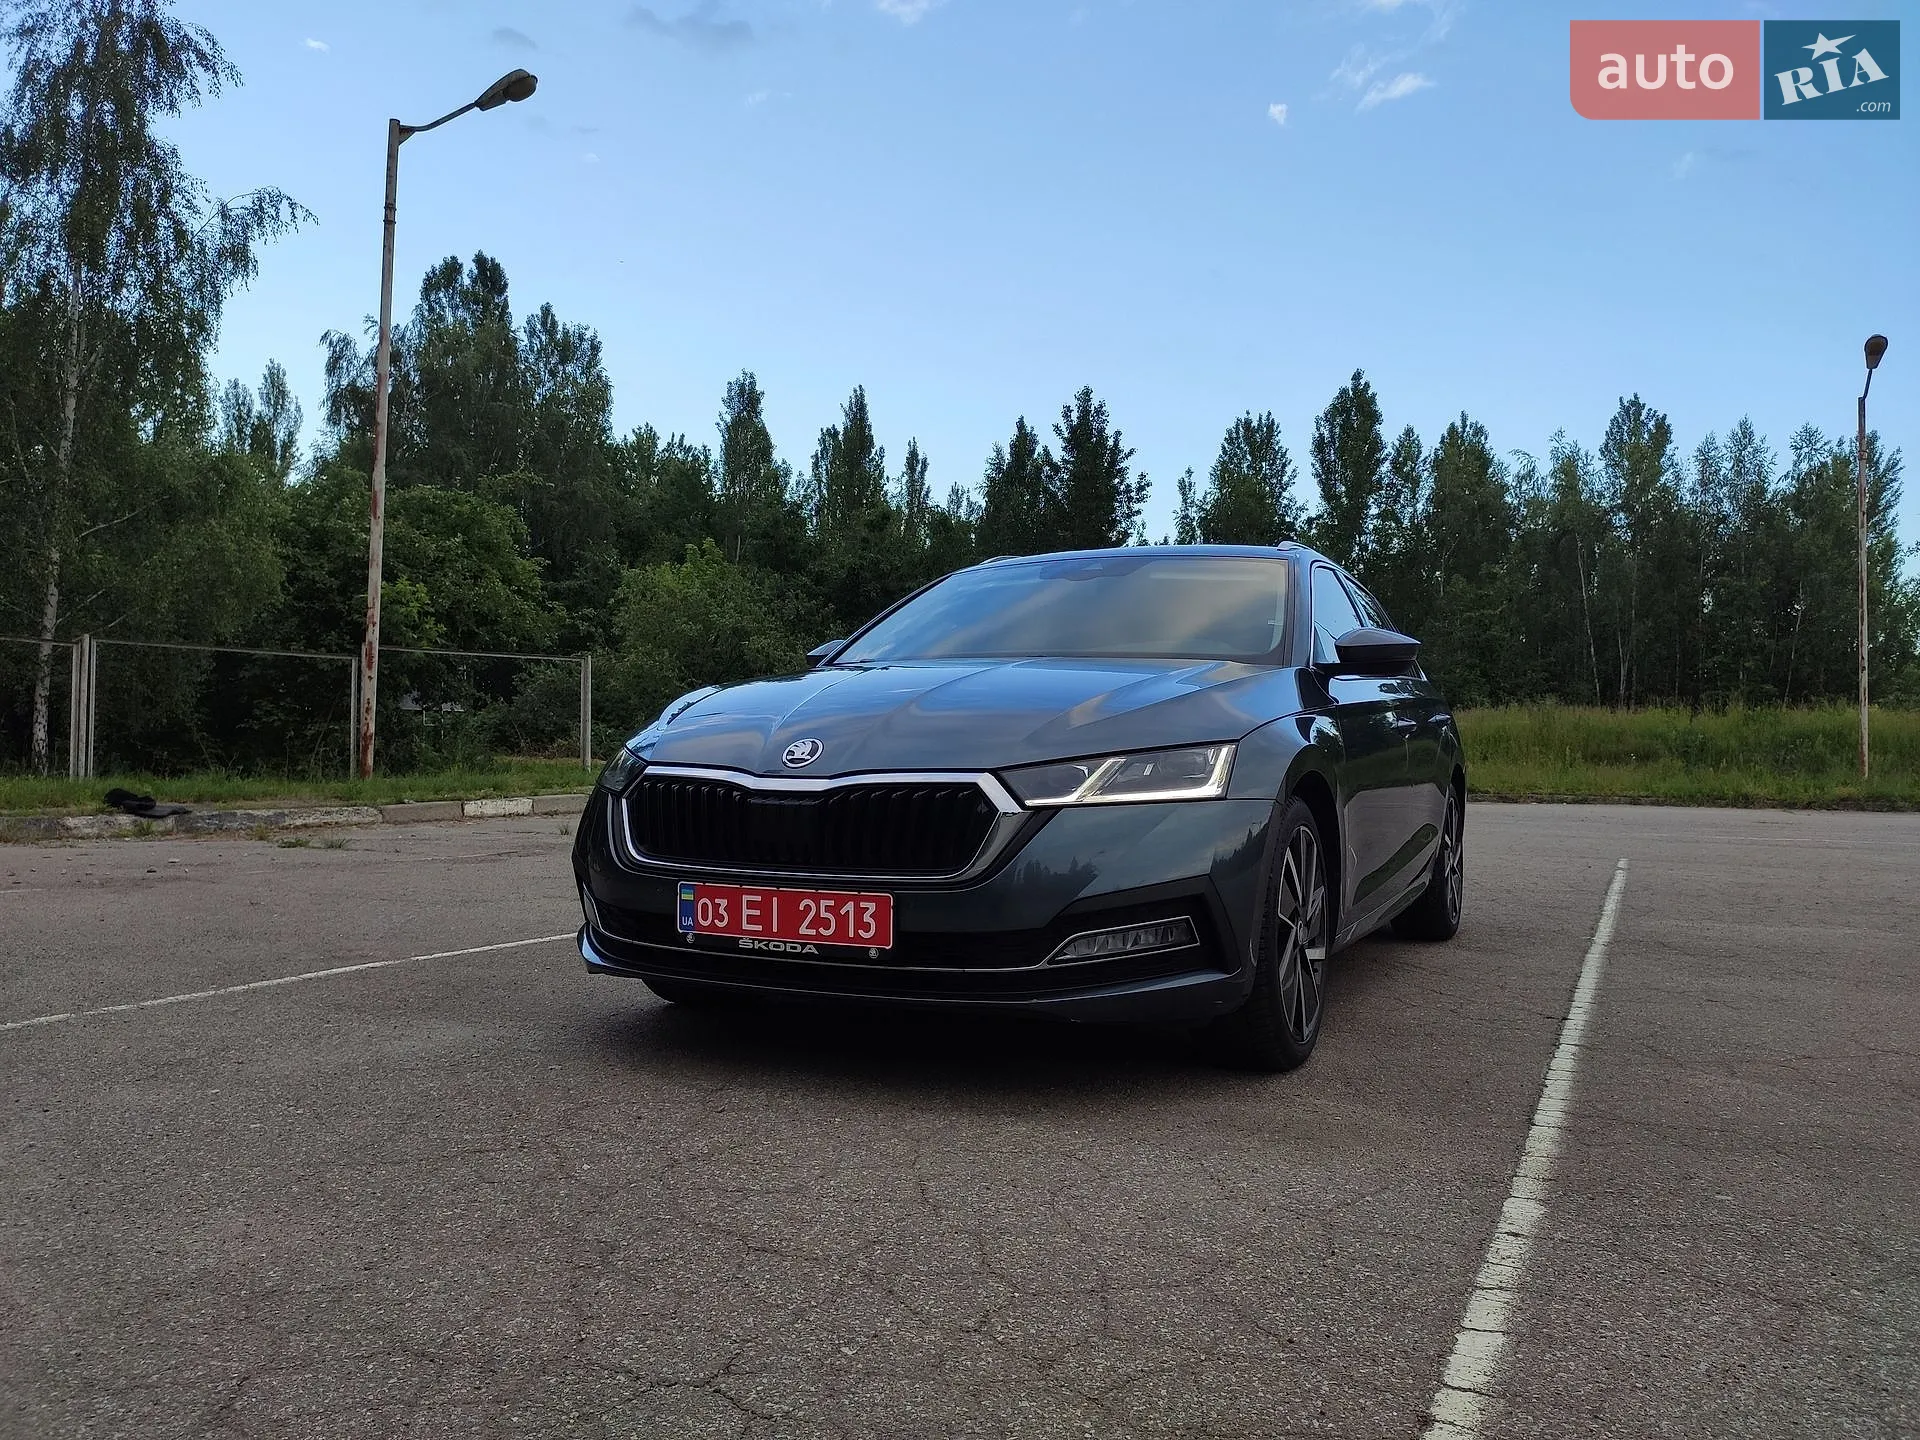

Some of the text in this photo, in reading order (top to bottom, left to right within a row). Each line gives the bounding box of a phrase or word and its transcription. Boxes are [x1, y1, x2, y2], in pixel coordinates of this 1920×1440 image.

[681, 916, 694, 927] UA
[697, 894, 876, 939] 03 EI 2513
[738, 937, 820, 955] ŠKODA
